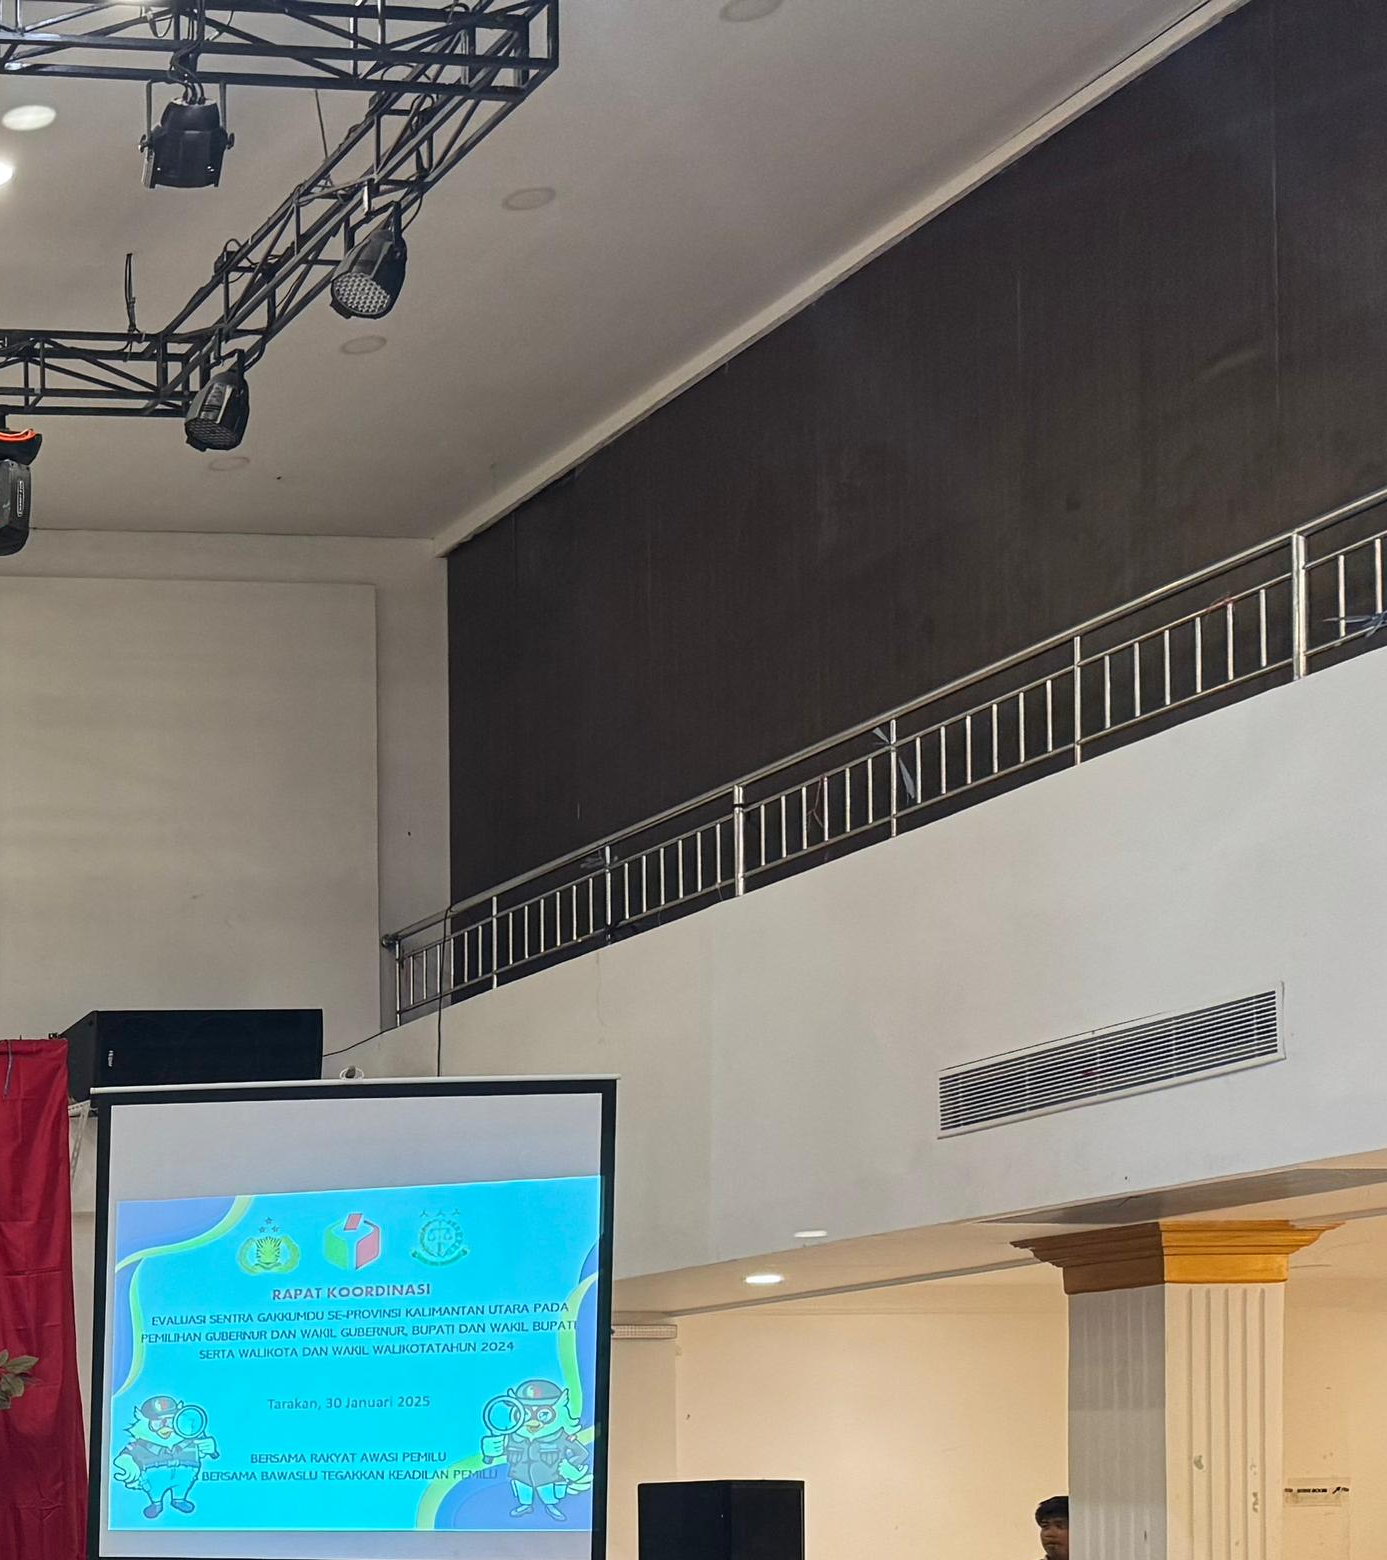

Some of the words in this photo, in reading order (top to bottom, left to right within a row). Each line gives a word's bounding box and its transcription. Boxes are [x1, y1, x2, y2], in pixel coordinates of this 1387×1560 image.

[272, 1287, 323, 1301] RAPAT
[327, 1283, 431, 1299] KOORDINASI
[151, 1314, 206, 1326] EVALUASI
[209, 1313, 254, 1324] SENTRA
[257, 1311, 325, 1323] GAKKUMDU
[327, 1308, 402, 1320] SE-PROVINSI
[405, 1305, 484, 1318] KALIMANTAN
[488, 1303, 529, 1314] UTARA
[533, 1302, 569, 1313] PADA
[141, 1332, 202, 1344] PEMILIHAN
[205, 1330, 267, 1342] GUBERNUR
[271, 1329, 297, 1340] DAN
[300, 1328, 337, 1339] WAKIL
[340, 1325, 408, 1338] GUBERNUR,
[412, 1324, 455, 1335] BUPATI
[459, 1323, 486, 1334] DAN
[490, 1321, 528, 1333] WAKIL
[533, 1320, 577, 1332] BUPATI
[199, 1349, 235, 1360] SERTA
[238, 1347, 299, 1358] WALIKOTA
[302, 1346, 328, 1357] DAN
[332, 1345, 369, 1356] WAKIL
[481, 1341, 515, 1352] 2024
[267, 1398, 322, 1411] Tarakan,
[325, 1398, 342, 1409] 30
[345, 1397, 393, 1409] Januari
[398, 1396, 431, 1408] 2025
[250, 1453, 307, 1464] BERSAMA
[310, 1453, 358, 1463] RAKYAT
[360, 1452, 398, 1463] AWASI
[402, 1451, 447, 1462] PEMILU
[202, 1471, 257, 1482] BERSAMA
[261, 1470, 318, 1481] BAWASLU
[322, 1470, 385, 1481] TEGAKKAN
[388, 1470, 449, 1481] KEADILAN
[453, 1469, 498, 1480] PEMILU
